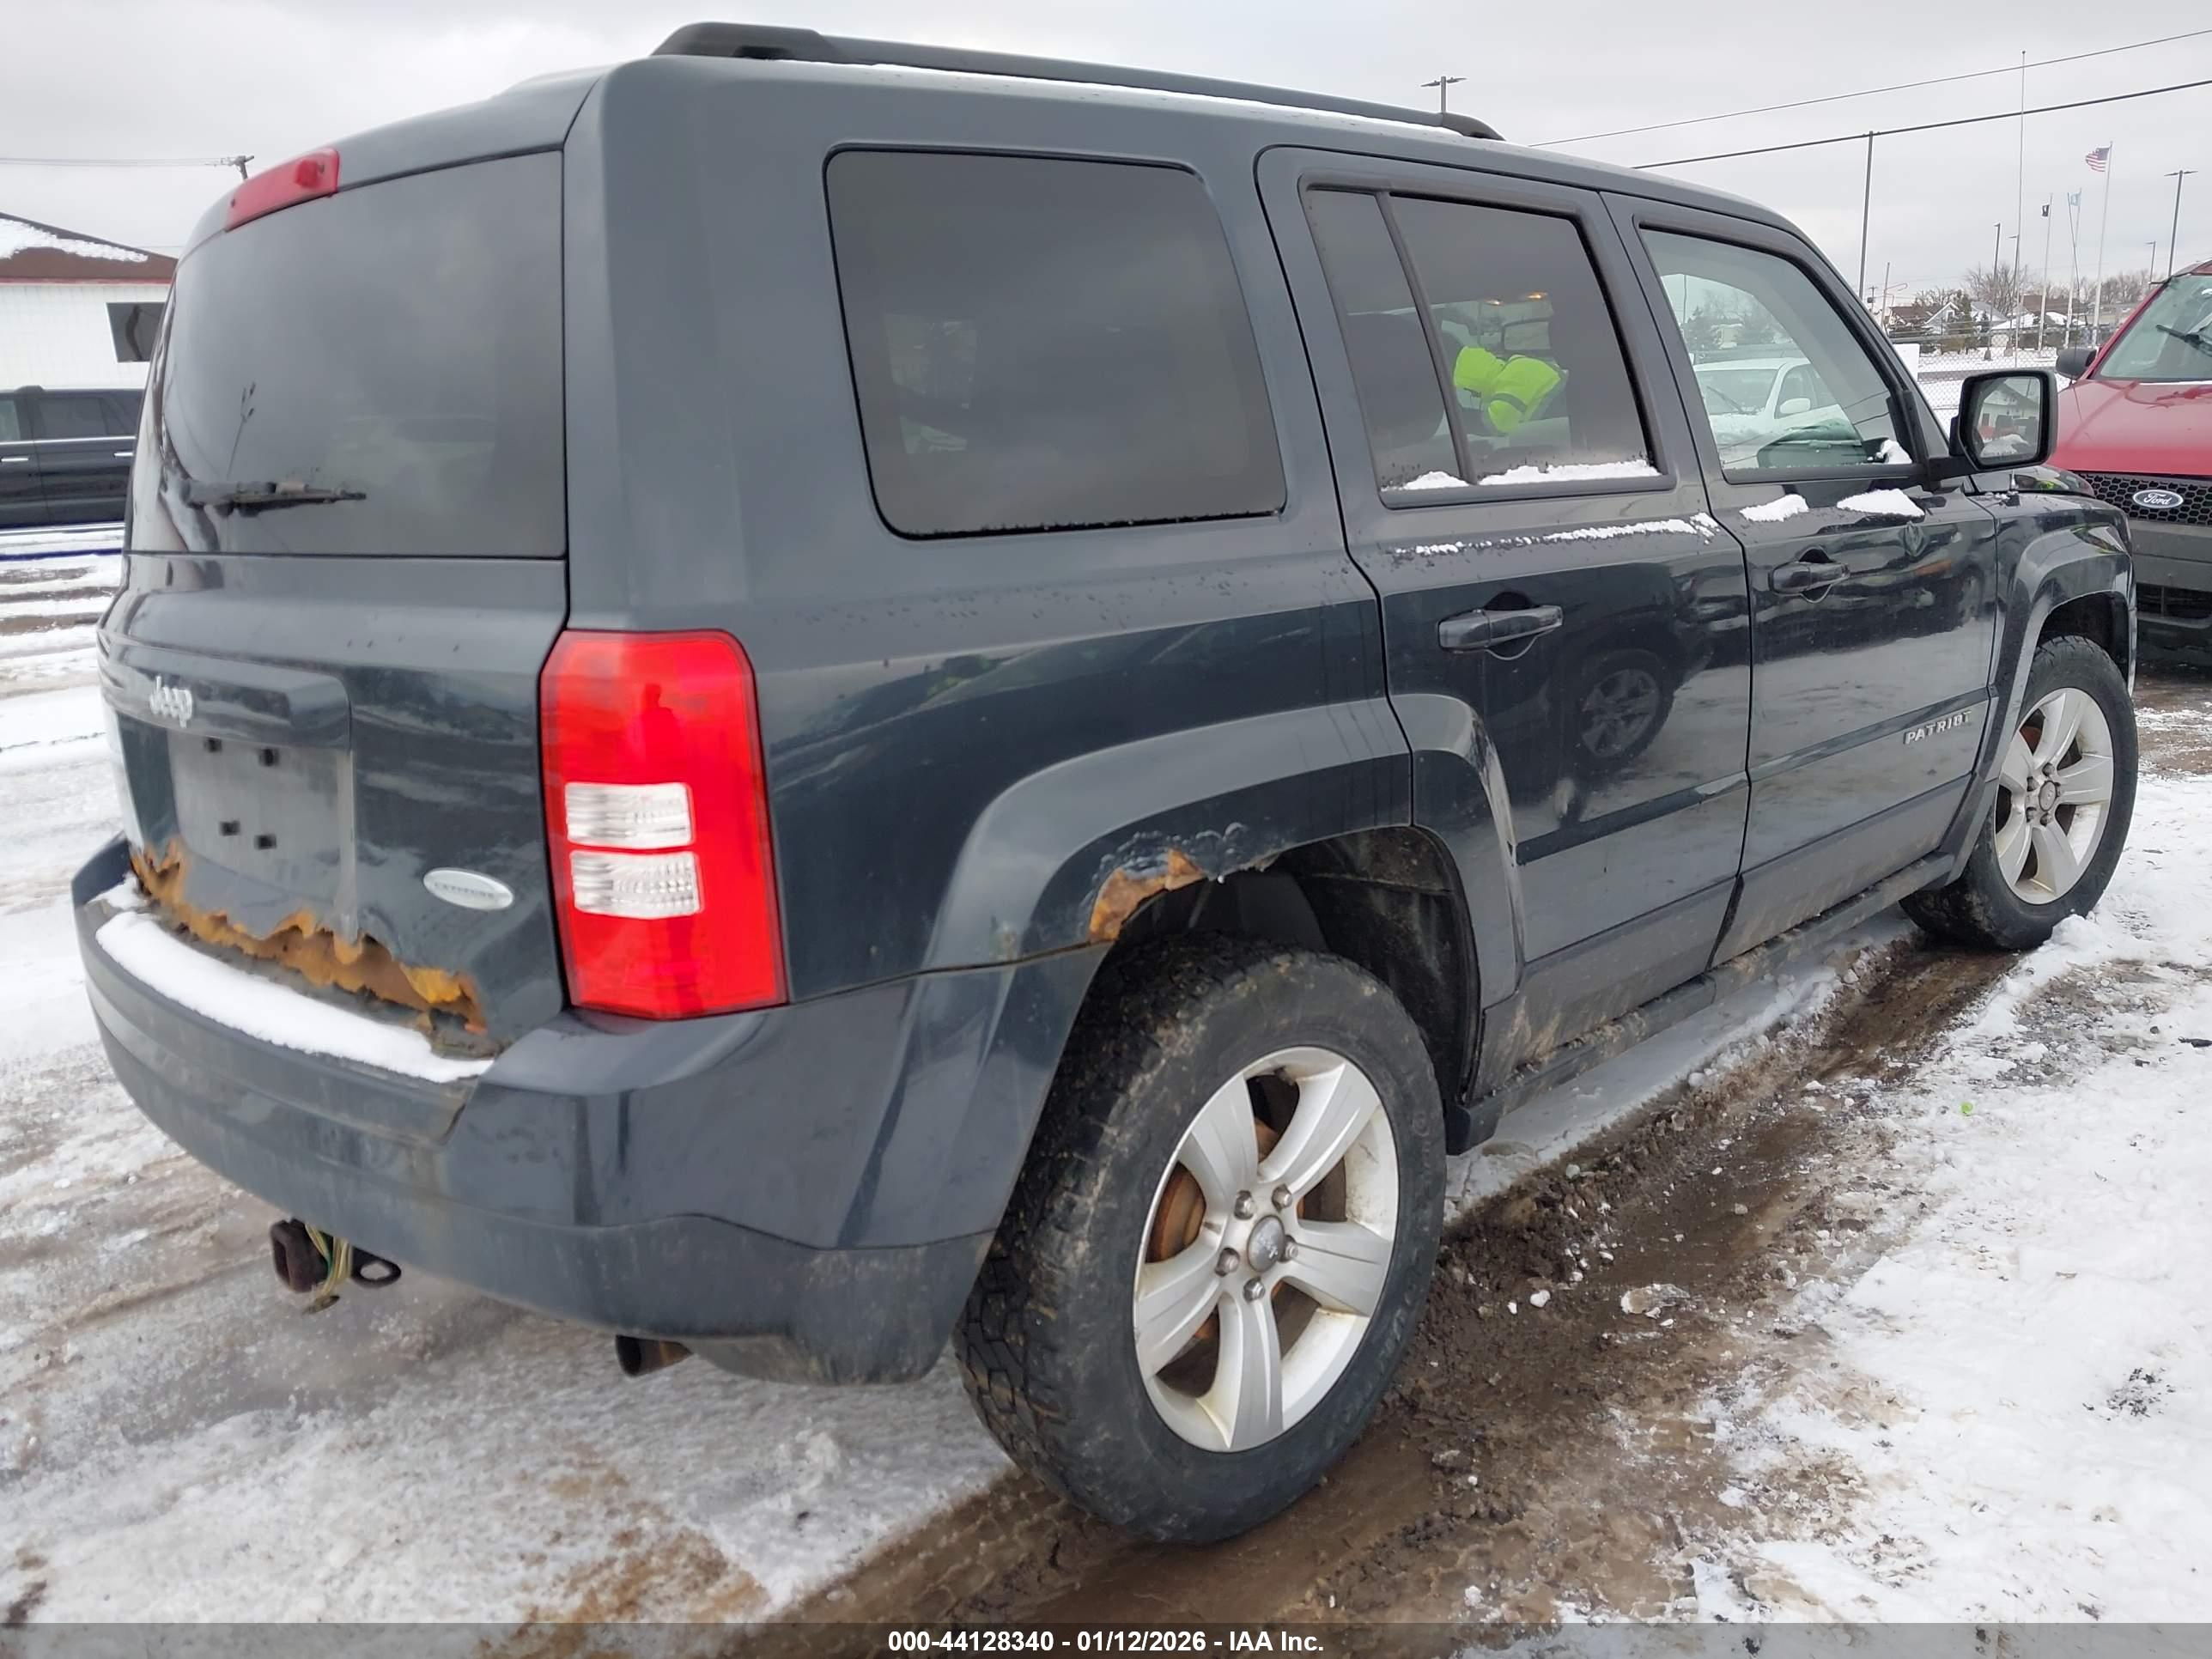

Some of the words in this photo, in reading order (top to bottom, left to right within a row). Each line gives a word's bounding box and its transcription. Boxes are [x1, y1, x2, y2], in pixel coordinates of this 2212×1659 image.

[2143, 492, 2172, 505] Ford
[149, 675, 192, 728] Jeep
[1904, 710, 1972, 744] PATRIOT
